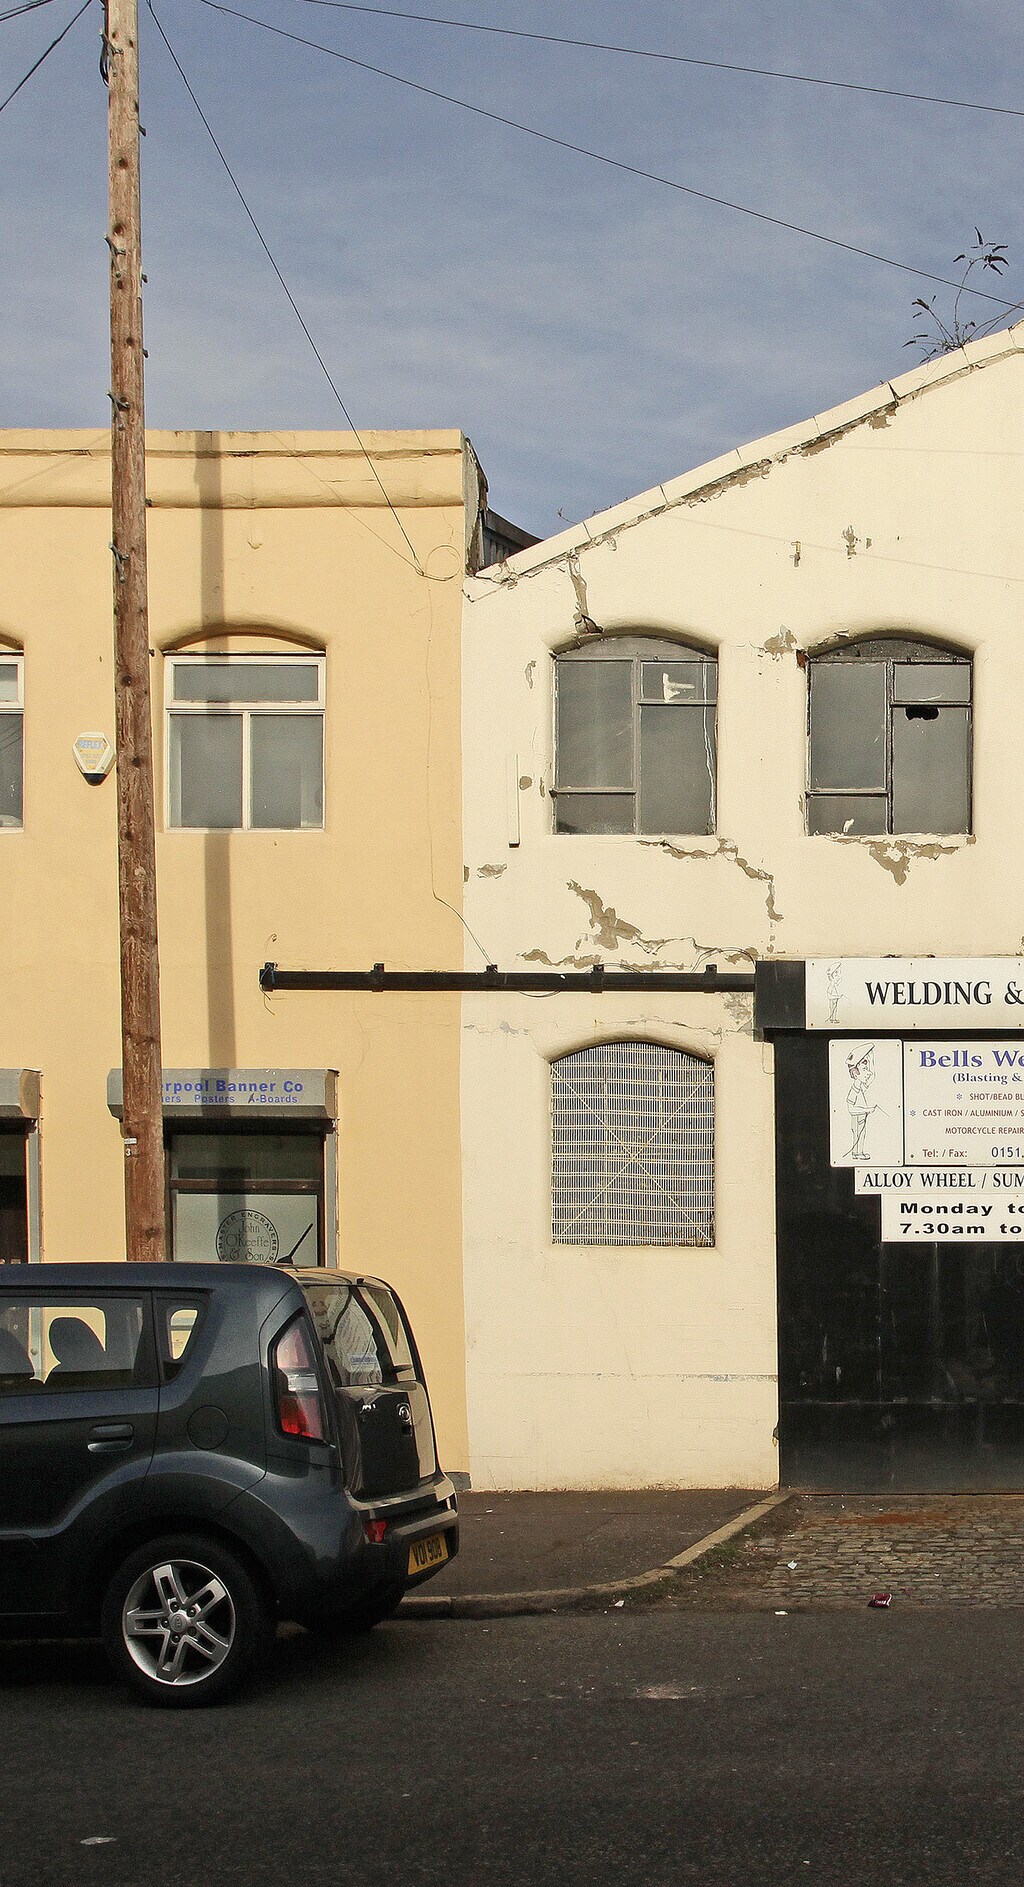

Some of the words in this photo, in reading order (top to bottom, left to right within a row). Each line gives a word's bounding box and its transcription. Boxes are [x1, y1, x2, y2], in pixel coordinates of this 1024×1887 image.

[865, 981, 992, 1006] WELDING
[919, 1049, 983, 1068] Bells
[952, 1073, 1008, 1085] (Blasting
[1011, 1073, 1023, 1083] &
[161, 1079, 209, 1094] rpool
[216, 1080, 276, 1092] Banner
[283, 1080, 303, 1092] Co
[194, 1094, 235, 1103] Posters
[248, 1094, 298, 1103] A-Boards
[969, 1093, 1013, 1101] SHOT/BEAD
[922, 1109, 943, 1117] CAST
[944, 1109, 963, 1117] IRON
[964, 1109, 969, 1117] /
[970, 1109, 1013, 1117] ALUMINIUM
[1014, 1109, 1019, 1117] /
[945, 1127, 996, 1135] MOTORCYCLE
[922, 1149, 939, 1158] Tel:
[942, 1149, 947, 1158] /
[949, 1149, 968, 1158] Fax:
[862, 1172, 913, 1188] ALLOY
[920, 1172, 977, 1188] WHEEL
[981, 1172, 987, 1189] /
[900, 1203, 993, 1217] Monday
[238, 1220, 260, 1233] John
[241, 1211, 277, 1251] ENGRAVERS
[900, 1223, 986, 1234] 7.30am
[1000, 1223, 1022, 1234] to
[245, 1248, 265, 1261] Son
